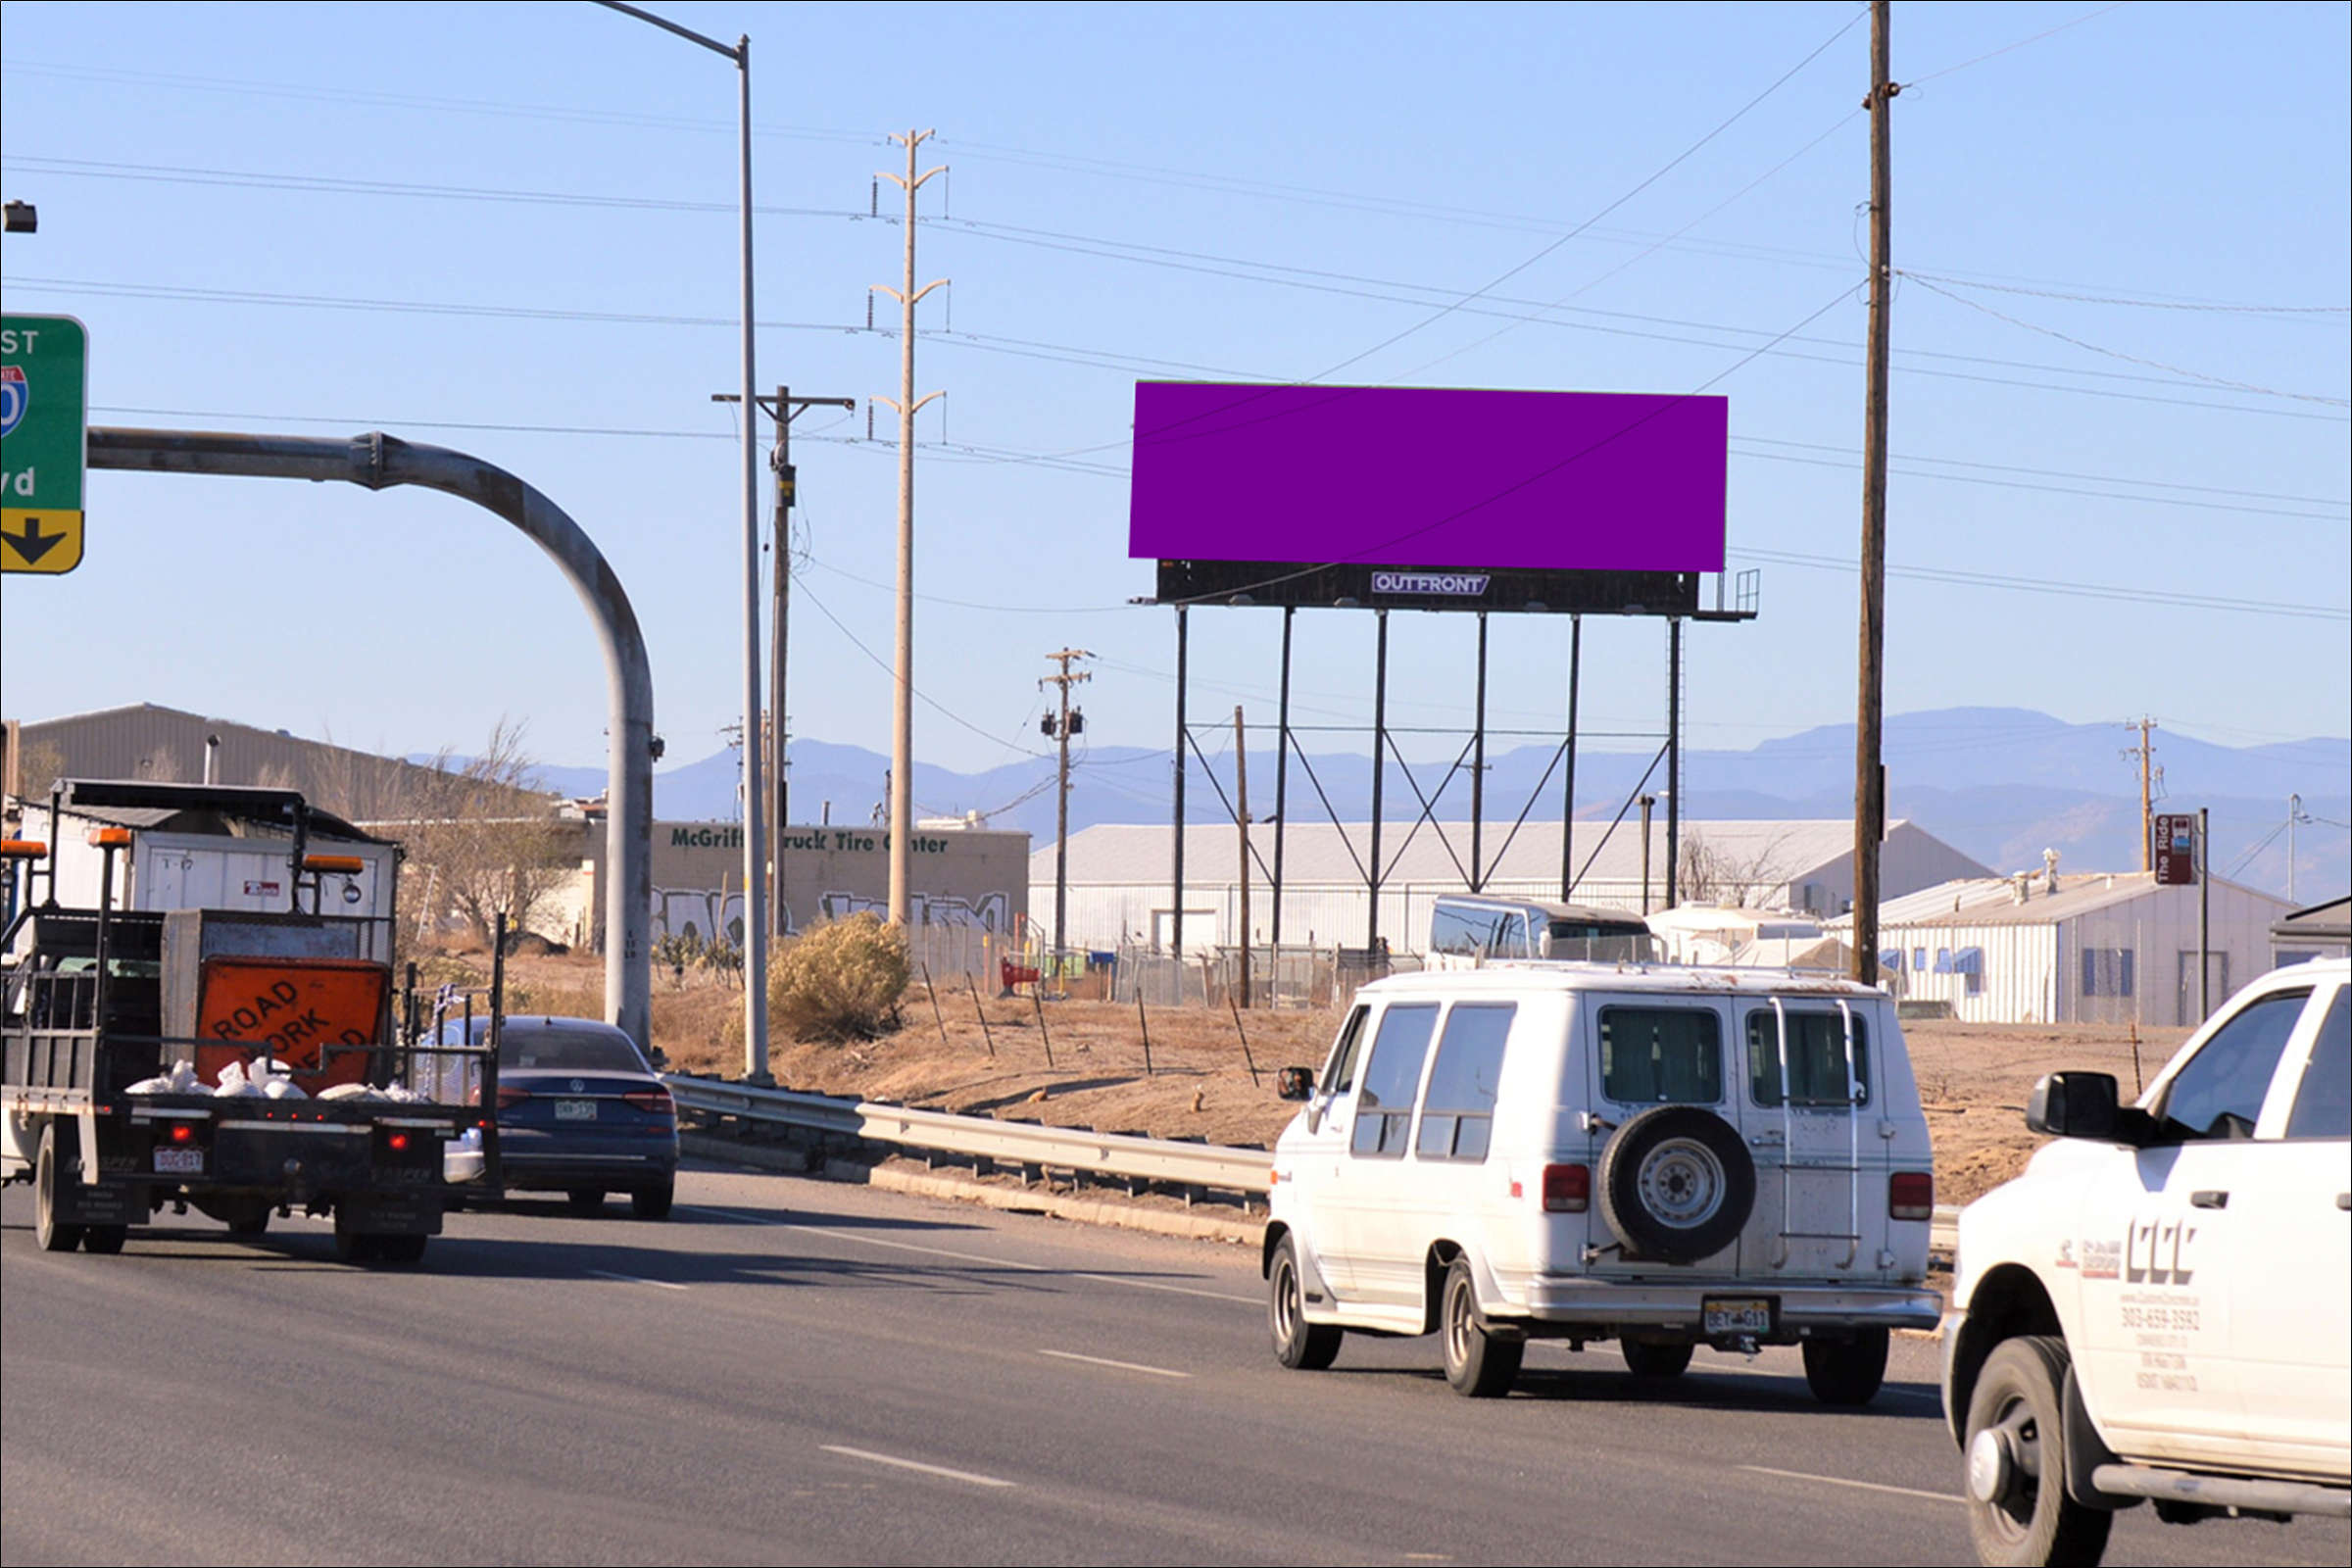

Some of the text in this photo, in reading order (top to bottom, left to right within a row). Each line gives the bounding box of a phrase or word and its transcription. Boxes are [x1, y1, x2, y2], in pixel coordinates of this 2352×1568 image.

[1376, 574, 1483, 592] OUTFRONT
[783, 829, 827, 851] ruck
[835, 831, 875, 852] Tire
[2158, 816, 2170, 851] Ride
[212, 981, 298, 1042] ROAD
